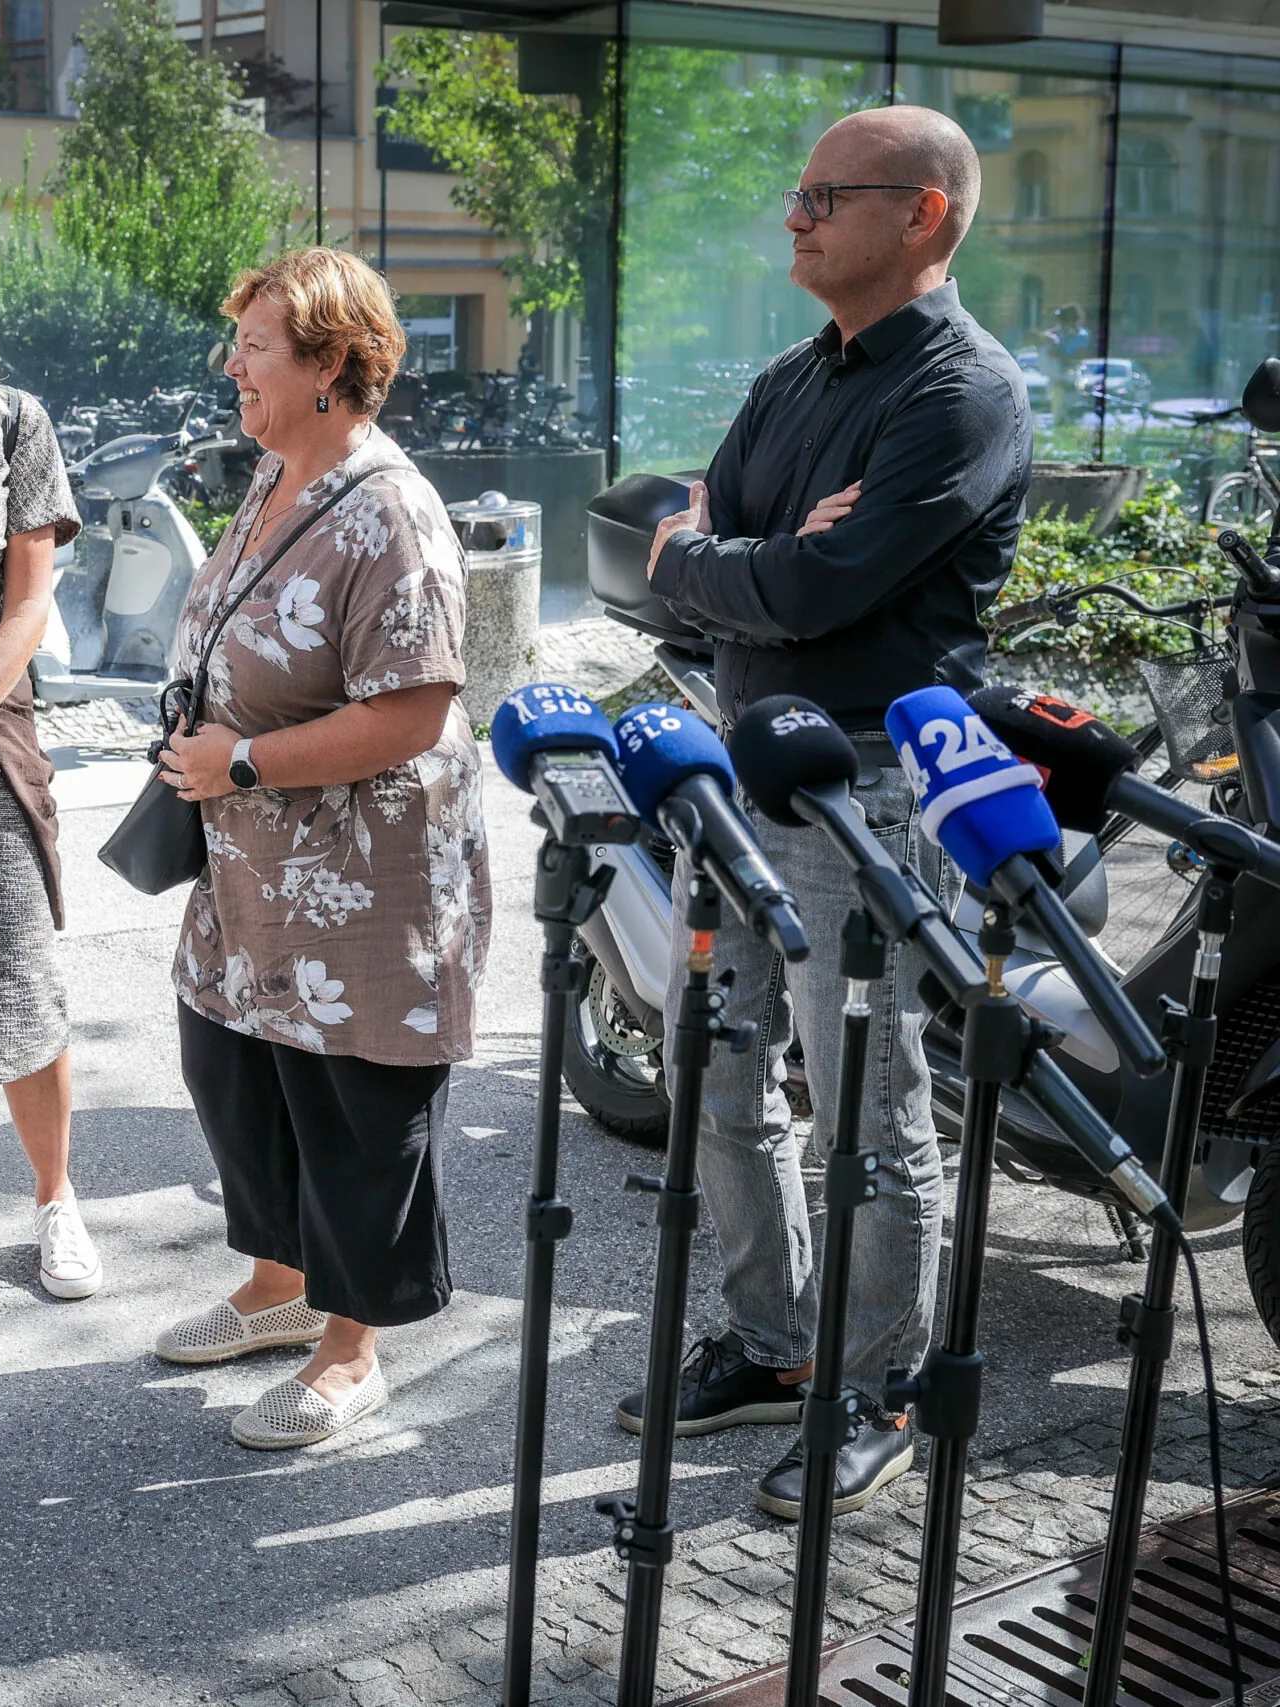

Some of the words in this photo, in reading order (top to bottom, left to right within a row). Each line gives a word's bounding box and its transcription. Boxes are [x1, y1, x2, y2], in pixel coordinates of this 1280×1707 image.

[531, 686, 582, 700] RTV
[540, 699, 593, 716] SLO
[619, 706, 668, 740] RTV
[627, 717, 682, 753] SLO
